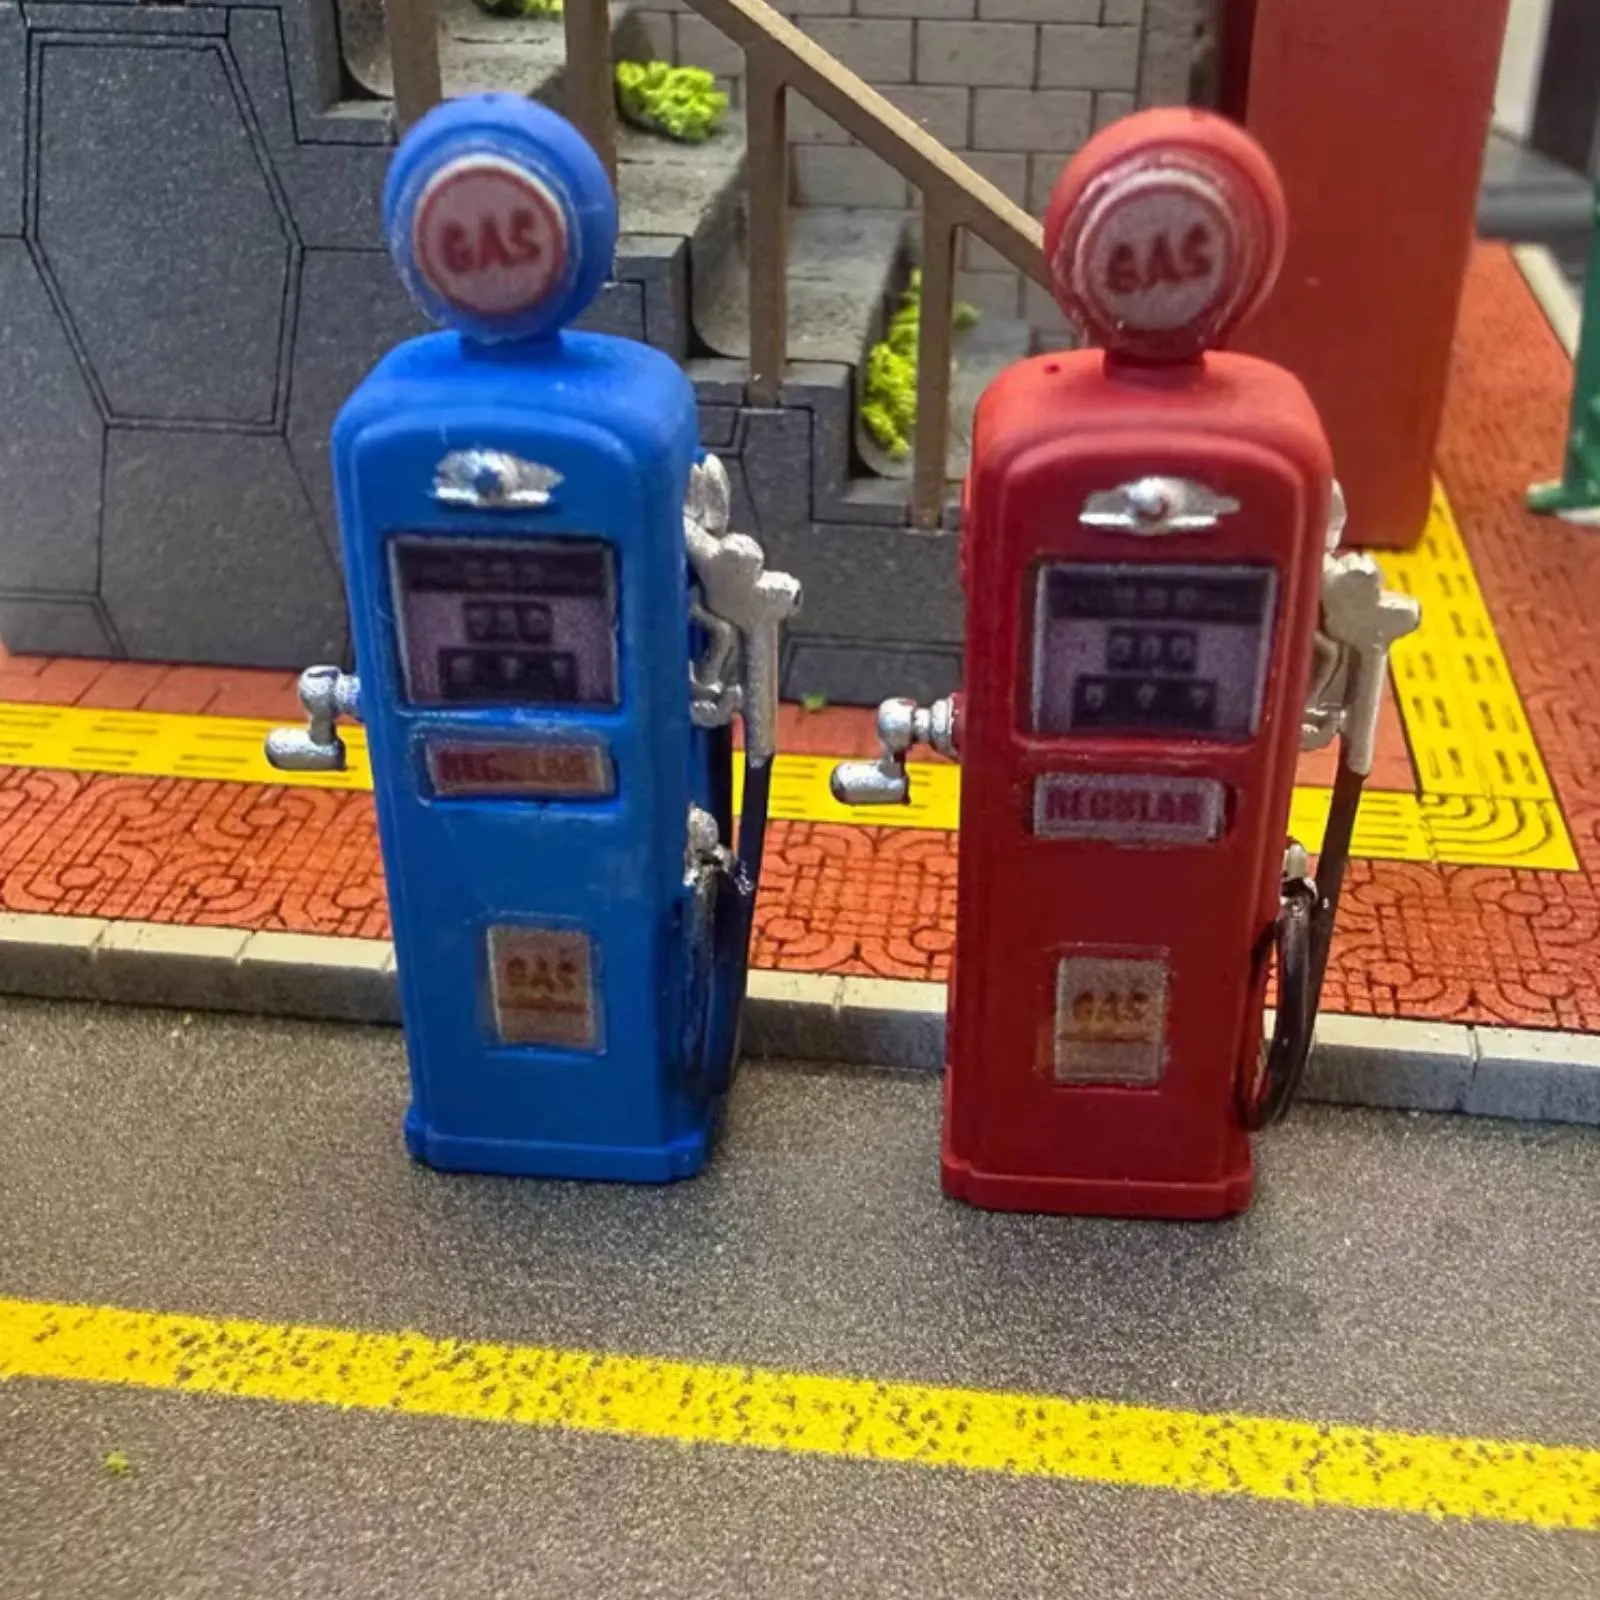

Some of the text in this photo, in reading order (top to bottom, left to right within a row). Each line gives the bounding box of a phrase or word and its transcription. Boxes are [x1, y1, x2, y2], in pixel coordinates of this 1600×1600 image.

[440, 206, 542, 273] GAS
[1106, 222, 1213, 294] GAS
[505, 953, 578, 993] GAS
